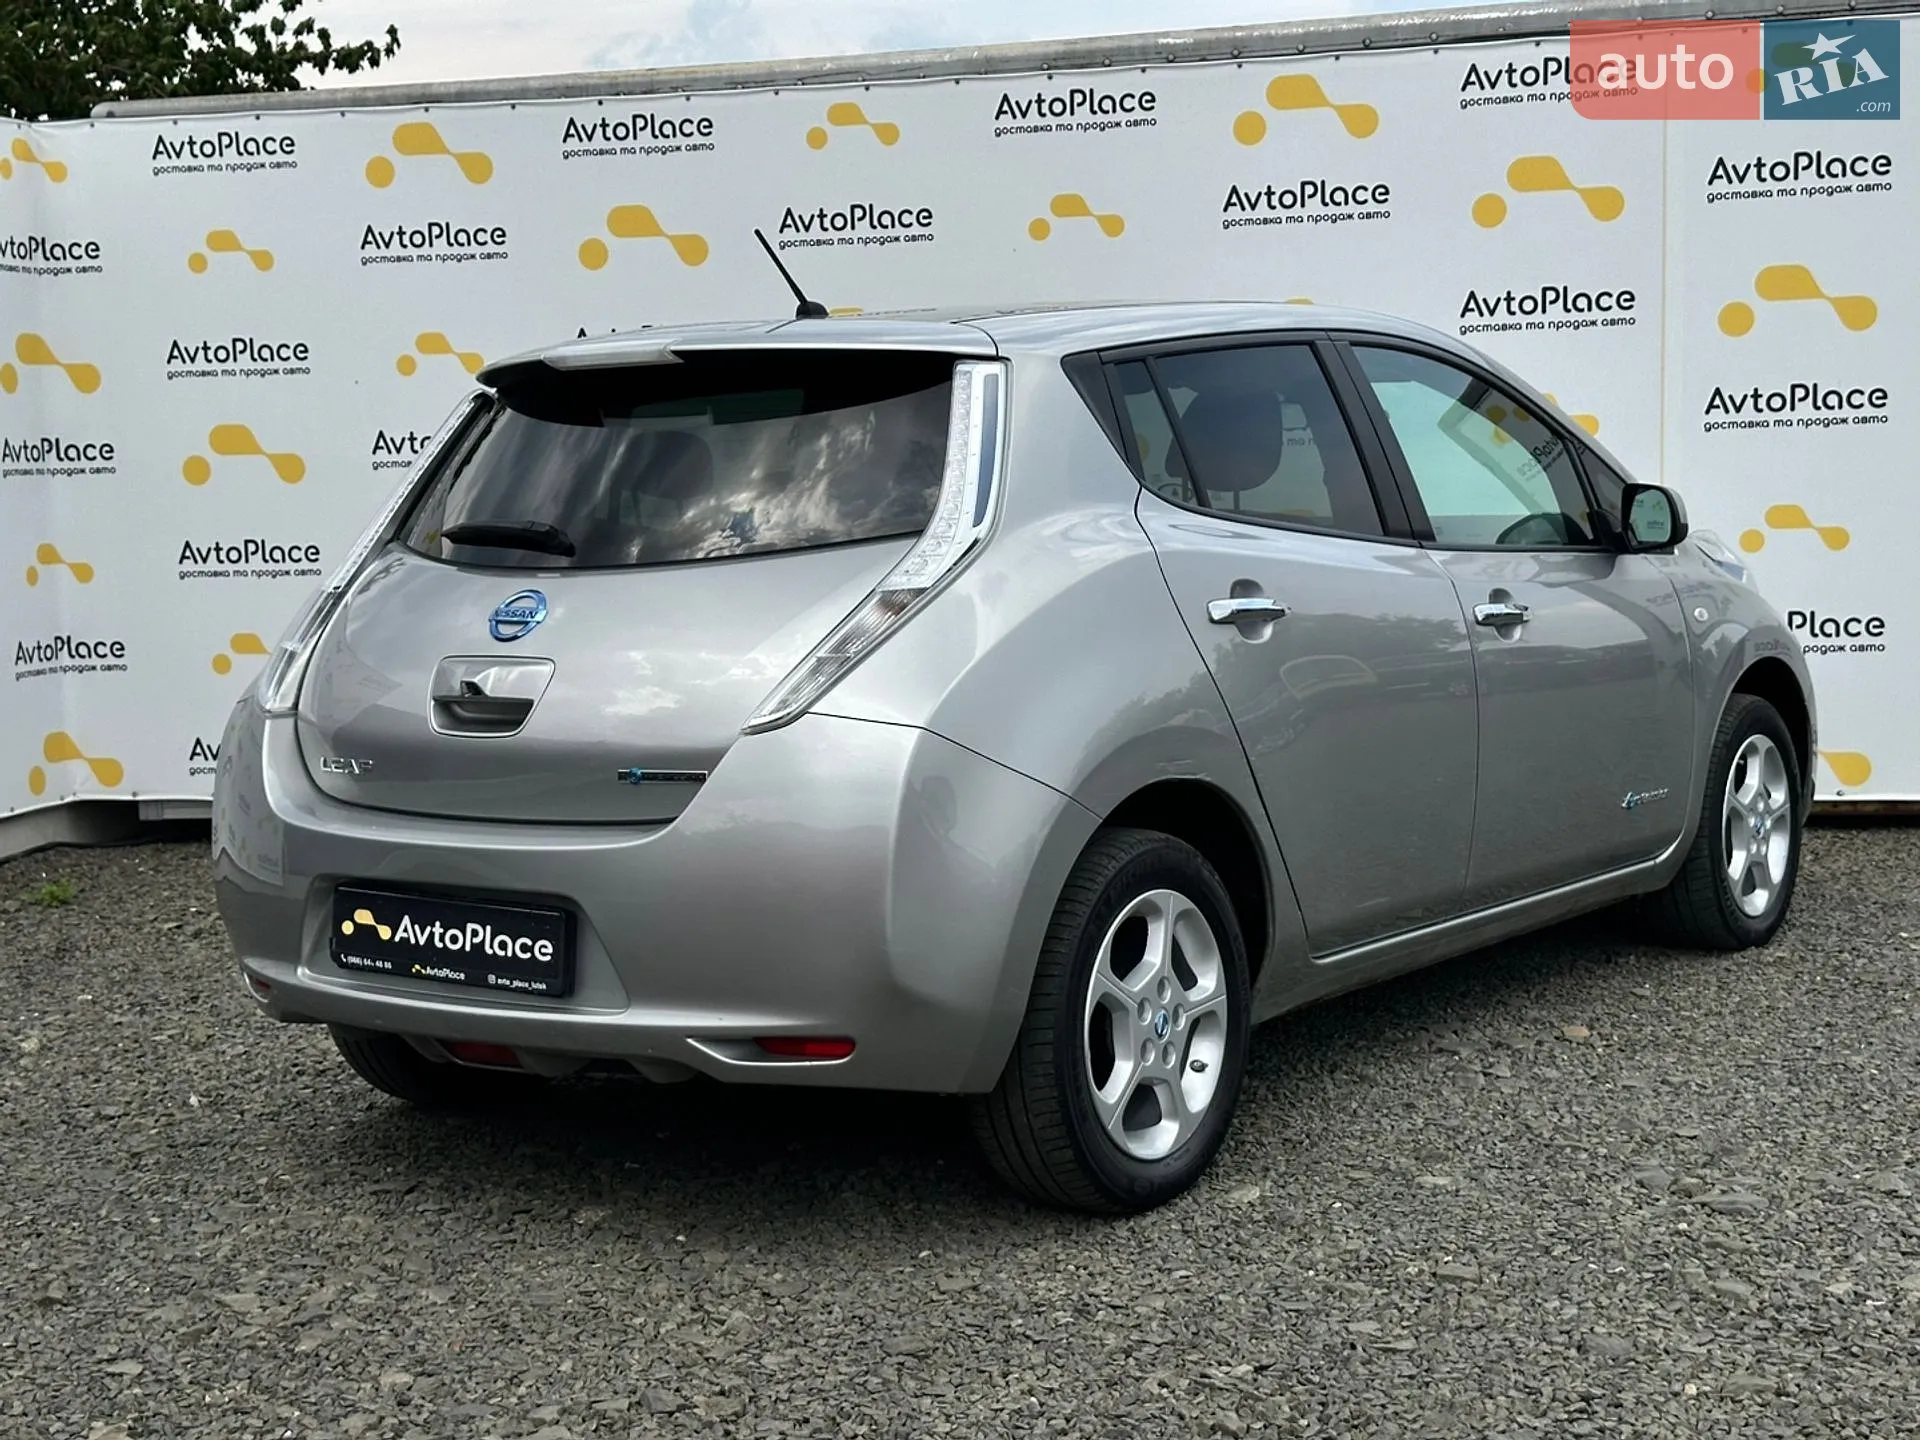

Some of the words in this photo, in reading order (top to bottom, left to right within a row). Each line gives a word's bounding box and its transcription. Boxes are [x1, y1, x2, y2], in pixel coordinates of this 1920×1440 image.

[995, 88, 1156, 121] AvtoPlace
[1460, 95, 1523, 110] доставка
[1527, 93, 1546, 102] та
[562, 113, 713, 144] AvtoPlace
[1055, 123, 1073, 131] та
[1076, 121, 1122, 133] продаж
[1125, 118, 1157, 127] авто
[152, 131, 295, 160] AvtoPlace
[620, 147, 636, 155] та
[639, 145, 682, 156] продаж
[685, 143, 715, 152] авто
[226, 162, 266, 173] продаж
[269, 161, 297, 169] авто
[1708, 151, 1892, 186] AvtoPlace
[1223, 179, 1390, 213] AvtoPlace
[1777, 188, 1797, 197] та
[1800, 185, 1853, 198] продаж
[1856, 183, 1892, 192] авто
[779, 203, 933, 234] AvtoPlace
[1286, 215, 1304, 224] та
[1307, 213, 1354, 225] продаж
[1358, 211, 1390, 220] авто
[0, 236, 100, 261] vtoPlace
[360, 222, 507, 250] AvtoPlace
[857, 236, 901, 247] продаж
[903, 234, 934, 242] авто
[416, 254, 433, 262] та
[435, 253, 477, 263] продаж
[479, 252, 508, 260] авто
[1460, 285, 1635, 318] AvtoPlace
[1526, 322, 1545, 330] та
[1548, 319, 1598, 331] продаж
[1601, 317, 1636, 326] авто
[167, 337, 309, 365] AvtoPlace
[239, 368, 280, 378] продаж
[282, 367, 311, 375] авто
[1704, 383, 1888, 415] AvtoPlace
[1774, 419, 1793, 428] та
[1797, 417, 1849, 429] продаж
[1852, 415, 1888, 424] авто
[2, 437, 114, 463] AvtoPlace
[372, 461, 412, 470] доста
[179, 539, 320, 565] AvtoPlace
[251, 569, 291, 579] продаж
[1787, 610, 1885, 638] Place
[15, 635, 125, 666] AvtoPlace
[1803, 645, 1846, 655] родаж
[1850, 643, 1885, 652] авто
[320, 756, 374, 775] LEAF
[394, 914, 554, 962] AvtoPlace
